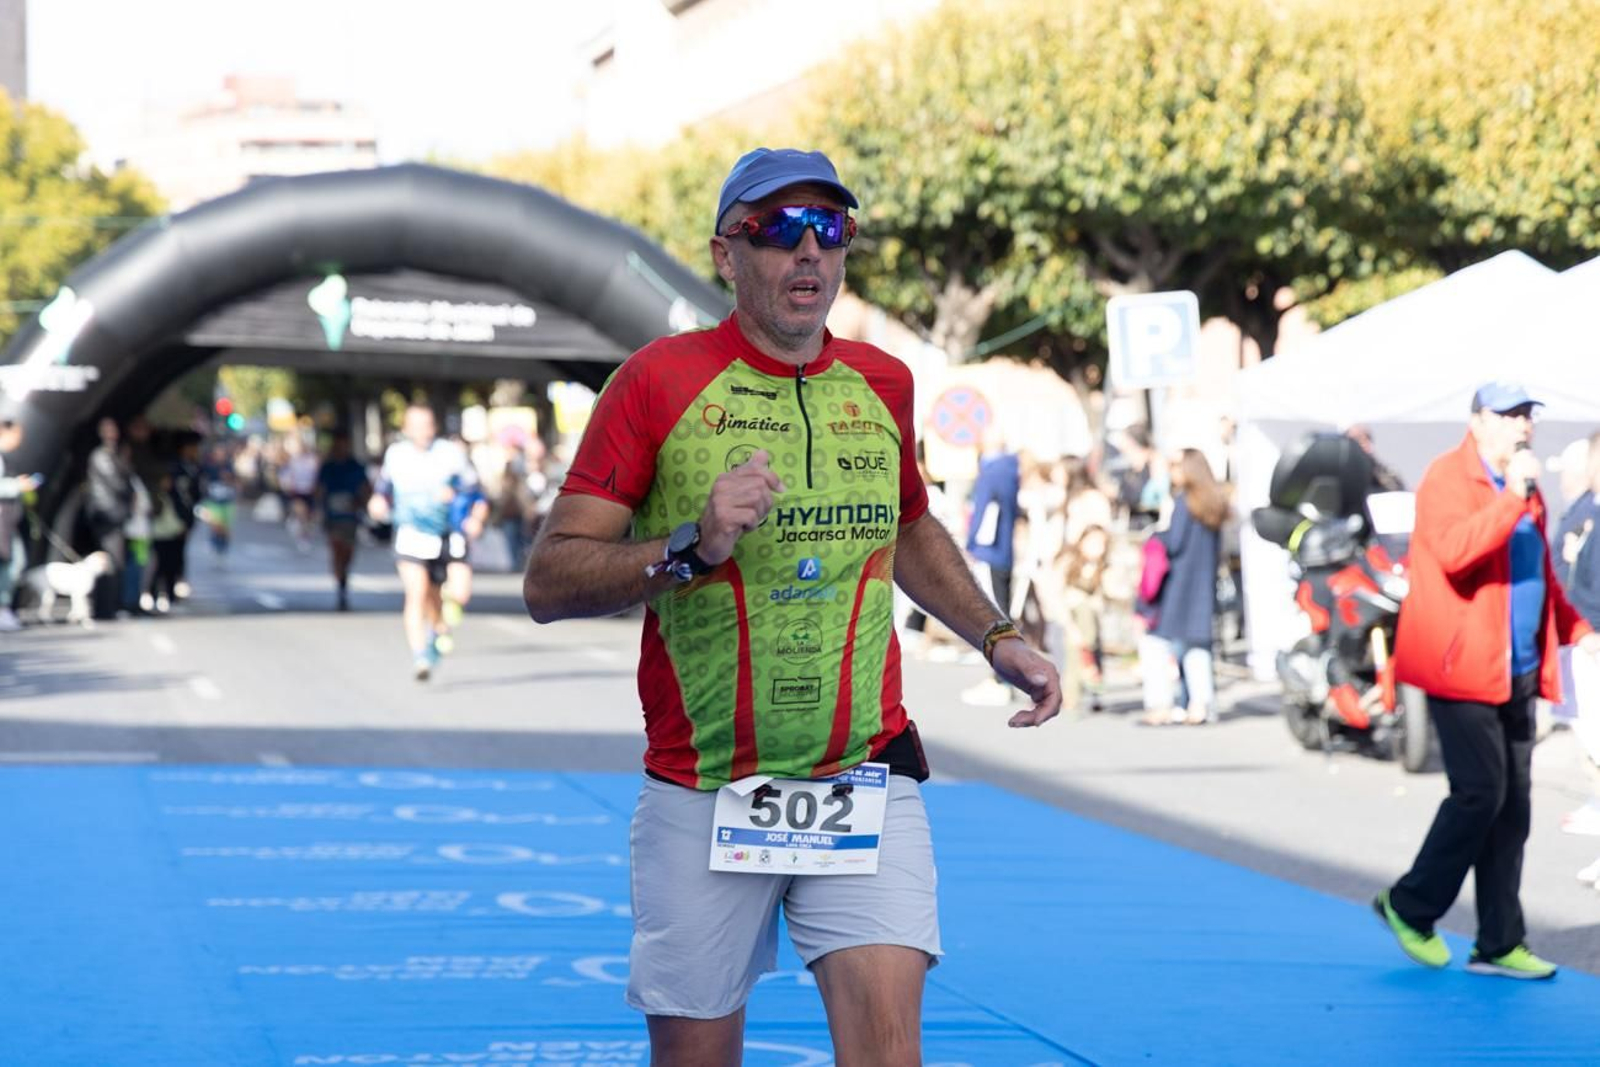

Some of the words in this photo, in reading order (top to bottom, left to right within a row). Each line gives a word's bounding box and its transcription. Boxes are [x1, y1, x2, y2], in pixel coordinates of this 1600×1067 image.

[1125, 305, 1183, 377] P
[854, 456, 889, 471] DUE
[776, 504, 894, 527] HYUNDAI
[776, 528, 844, 543] Jacarsa
[749, 785, 854, 833] 502
[765, 832, 788, 843] JOSÉ
[791, 833, 835, 846] MANUEL
